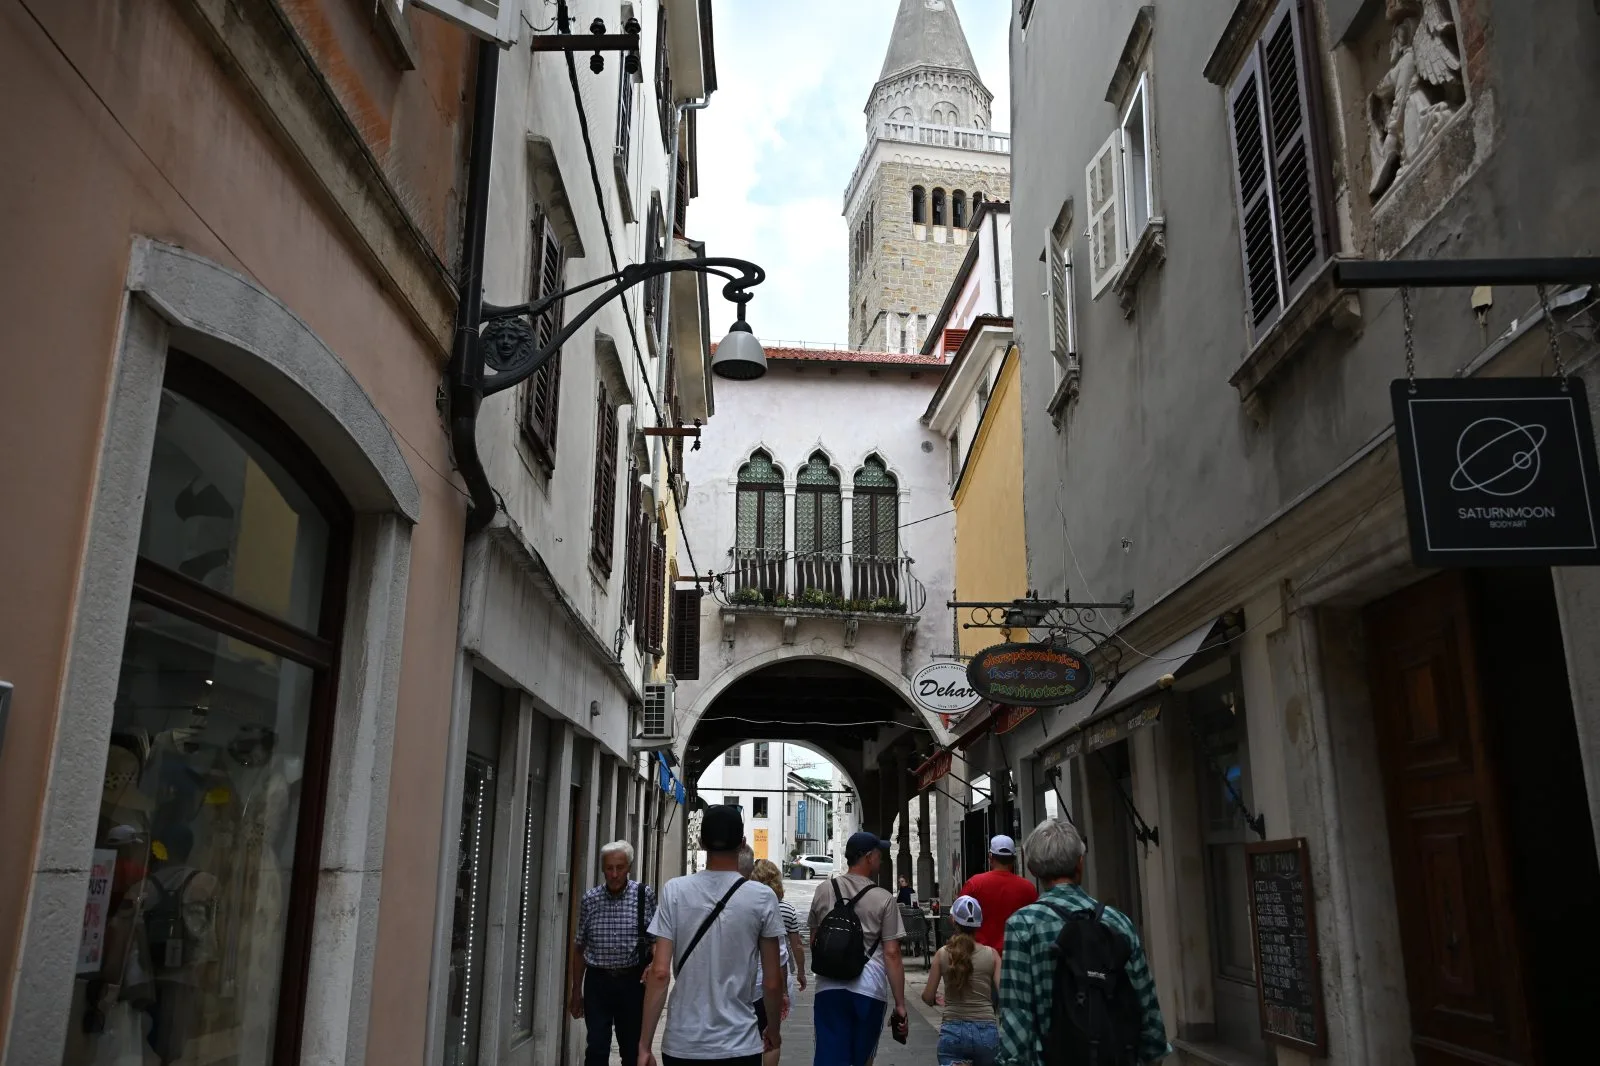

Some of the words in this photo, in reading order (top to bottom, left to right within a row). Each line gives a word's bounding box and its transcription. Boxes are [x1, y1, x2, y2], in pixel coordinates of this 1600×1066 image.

[1458, 506, 1555, 519] SATURNMOON
[987, 667, 1020, 680] fast
[1064, 668, 1076, 681] 2
[919, 679, 976, 698] Dehar
[989, 682, 1076, 698] paninoteca
[1255, 855, 1271, 873] FAST
